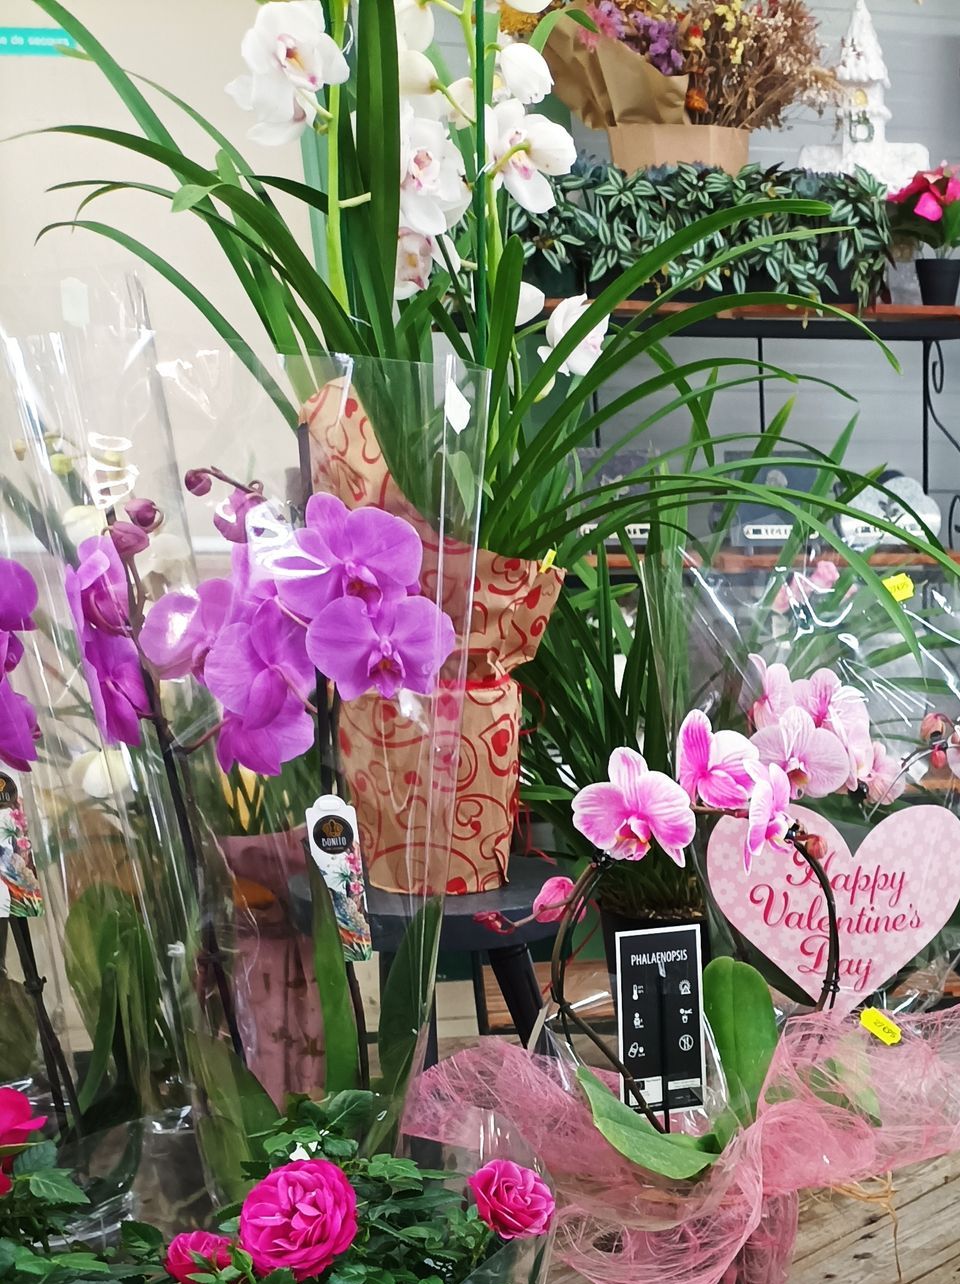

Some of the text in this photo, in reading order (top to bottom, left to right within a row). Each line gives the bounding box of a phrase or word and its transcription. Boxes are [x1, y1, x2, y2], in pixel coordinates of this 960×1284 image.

[321, 836, 347, 848] BONITO
[785, 850, 906, 908] Happy
[749, 883, 921, 936] Valentine's
[630, 949, 688, 966] PHALAENOPSIS
[797, 934, 873, 992] Day
